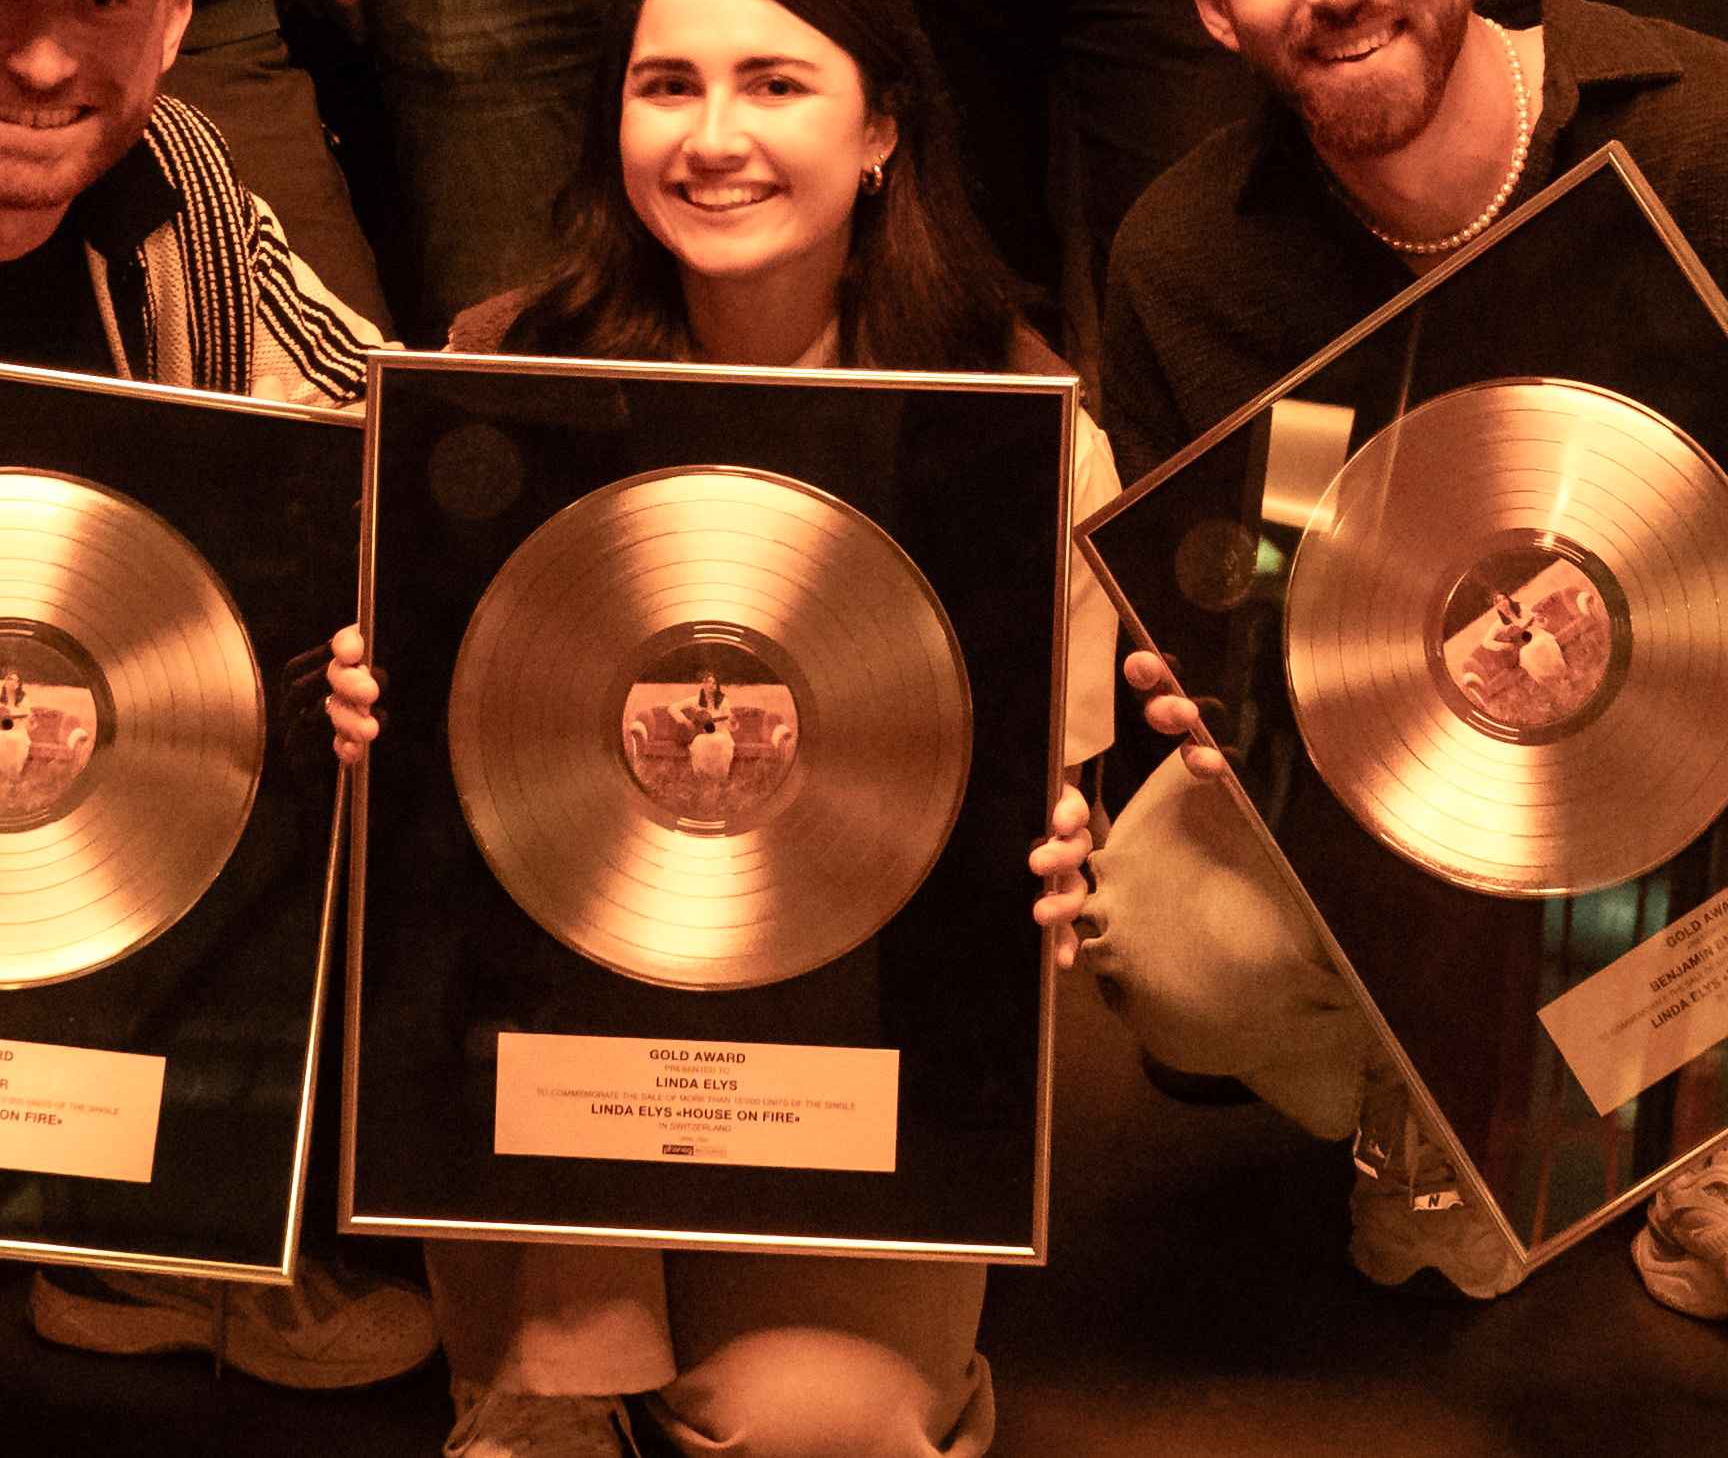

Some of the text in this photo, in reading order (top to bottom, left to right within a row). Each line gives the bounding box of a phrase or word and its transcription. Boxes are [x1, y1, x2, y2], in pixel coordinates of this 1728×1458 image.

[1666, 919, 1702, 948] GOLD
[1649, 945, 1714, 992] BENJAMIN
[1650, 999, 1690, 1029] LINDA
[1690, 978, 1721, 1002] ELYS
[649, 1049, 746, 1064] GOLD AWARD
[656, 1076, 738, 1091] LINDA ELYS
[0, 1109, 20, 1121] ON
[591, 1103, 633, 1116] LINDA
[639, 1105, 672, 1117] ELYS
[737, 1110, 758, 1121] ON
